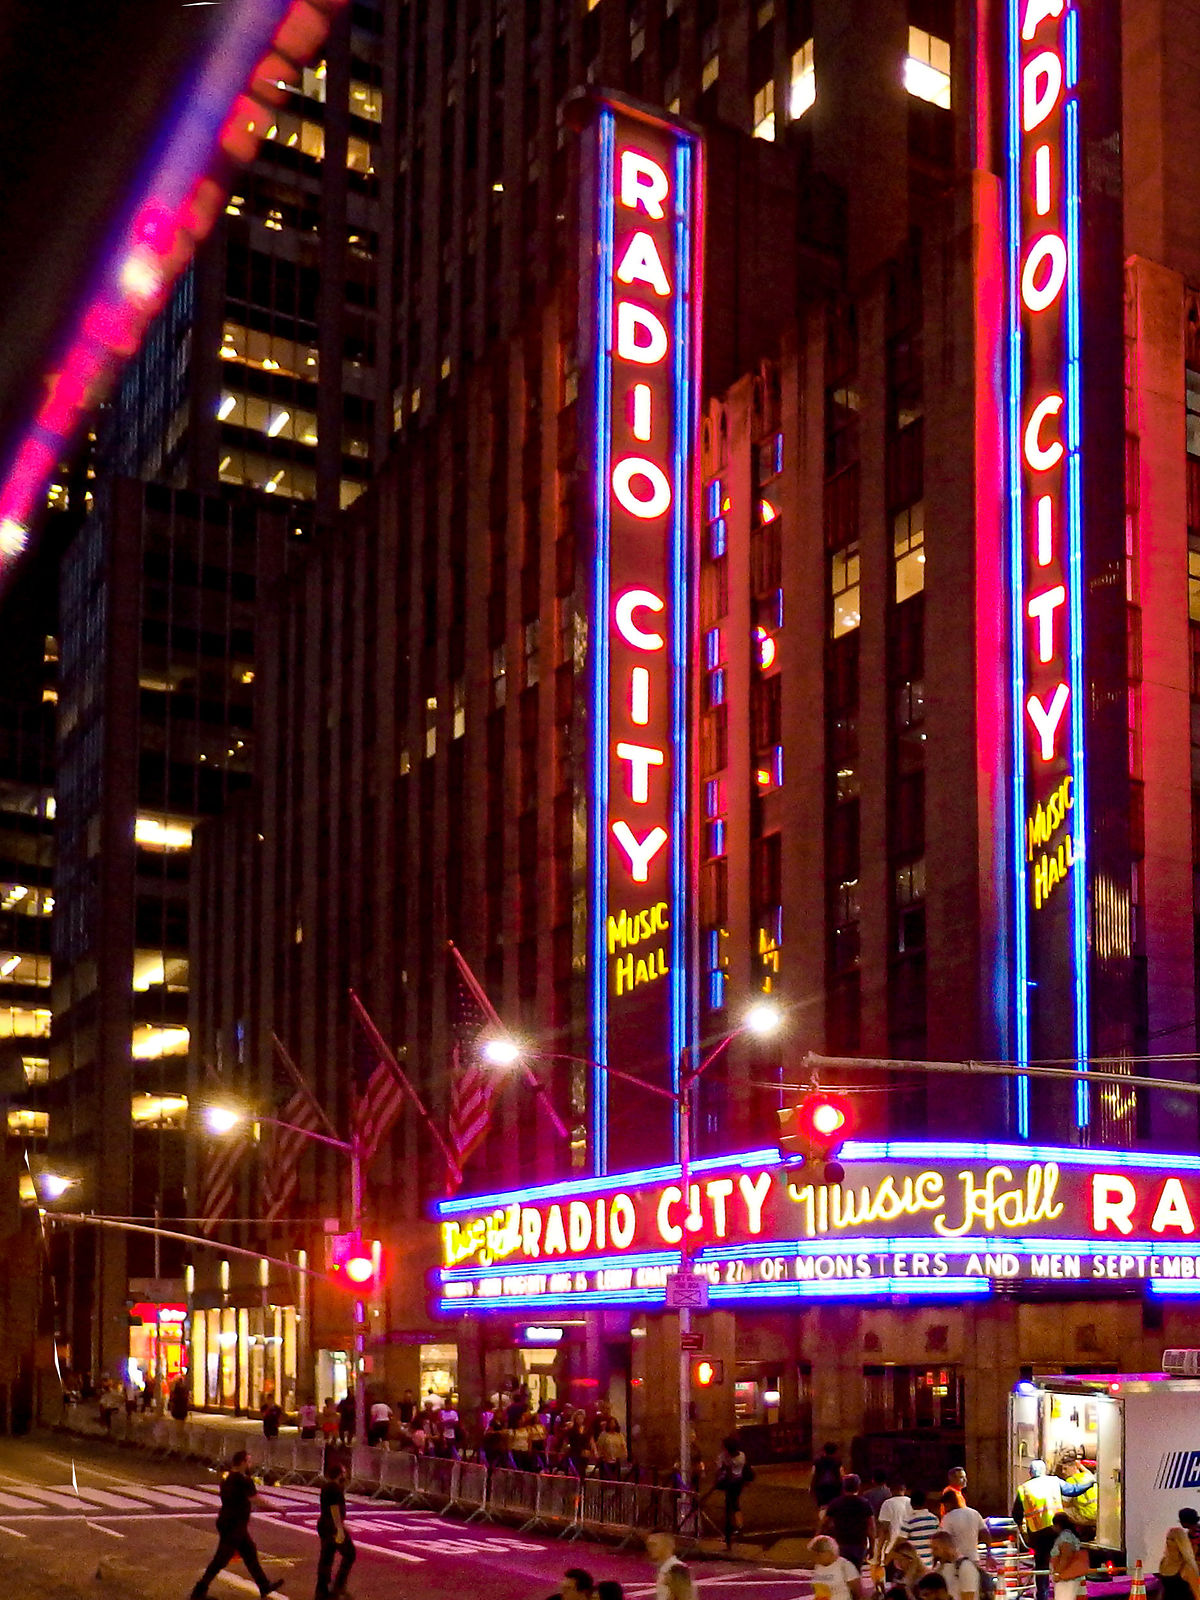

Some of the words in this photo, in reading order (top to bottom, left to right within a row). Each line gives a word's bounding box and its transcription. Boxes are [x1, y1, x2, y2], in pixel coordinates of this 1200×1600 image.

[611, 149, 672, 519] RADIO
[1024, 395, 1069, 761] CITY
[611, 589, 668, 882] CITY
[616, 948, 669, 996] HALL
[521, 1193, 636, 1257] RADIO
[656, 1171, 772, 1243] CITY
[788, 1171, 945, 1237] Music
[934, 1162, 1064, 1237] Hall
[760, 1258, 785, 1281] OF
[795, 1253, 949, 1280] MONSTERS
[965, 1253, 1020, 1277] AND
[1030, 1254, 1081, 1278] MEN
[389, 1537, 548, 1555] BUS
